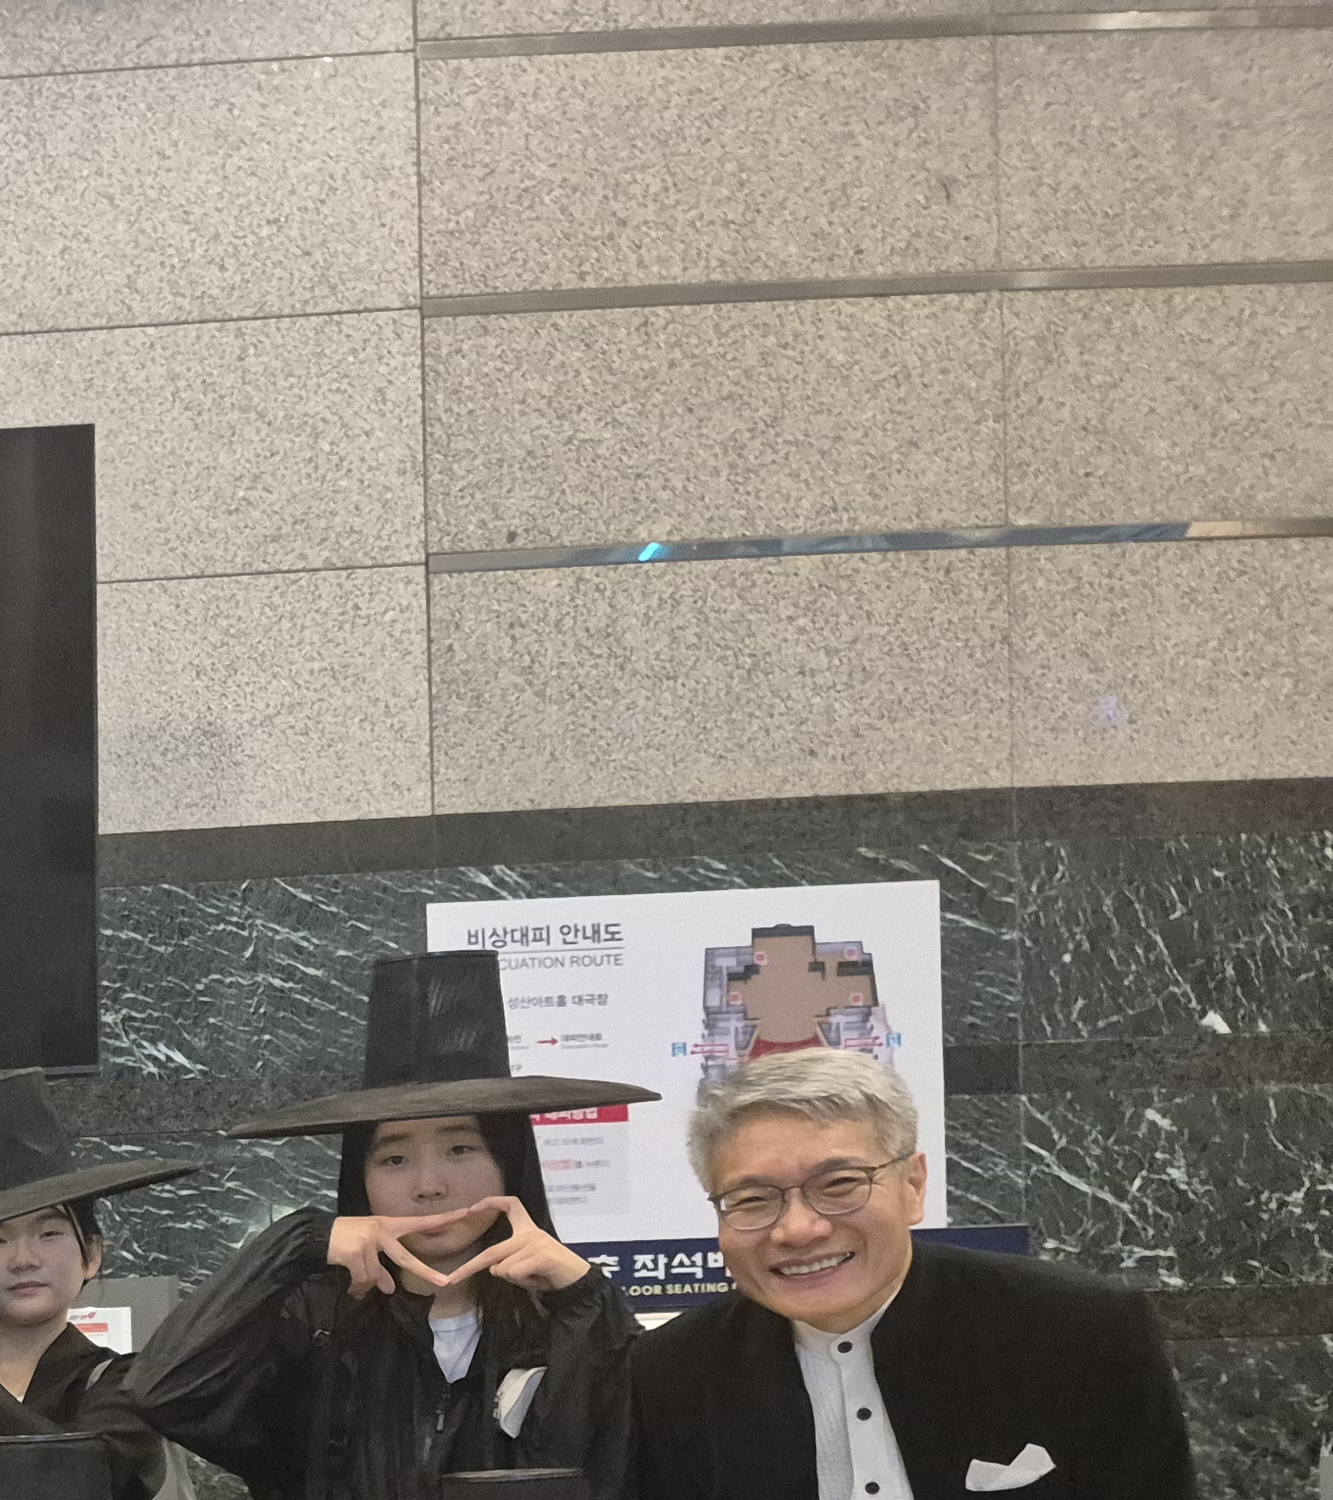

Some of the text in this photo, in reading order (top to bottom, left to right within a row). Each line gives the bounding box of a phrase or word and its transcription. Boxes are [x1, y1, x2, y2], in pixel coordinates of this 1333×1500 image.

[466, 922, 624, 949] 비상대피 안내도
[499, 953, 624, 971] CUATION ROUTE
[665, 1281, 730, 1295] SEATING
